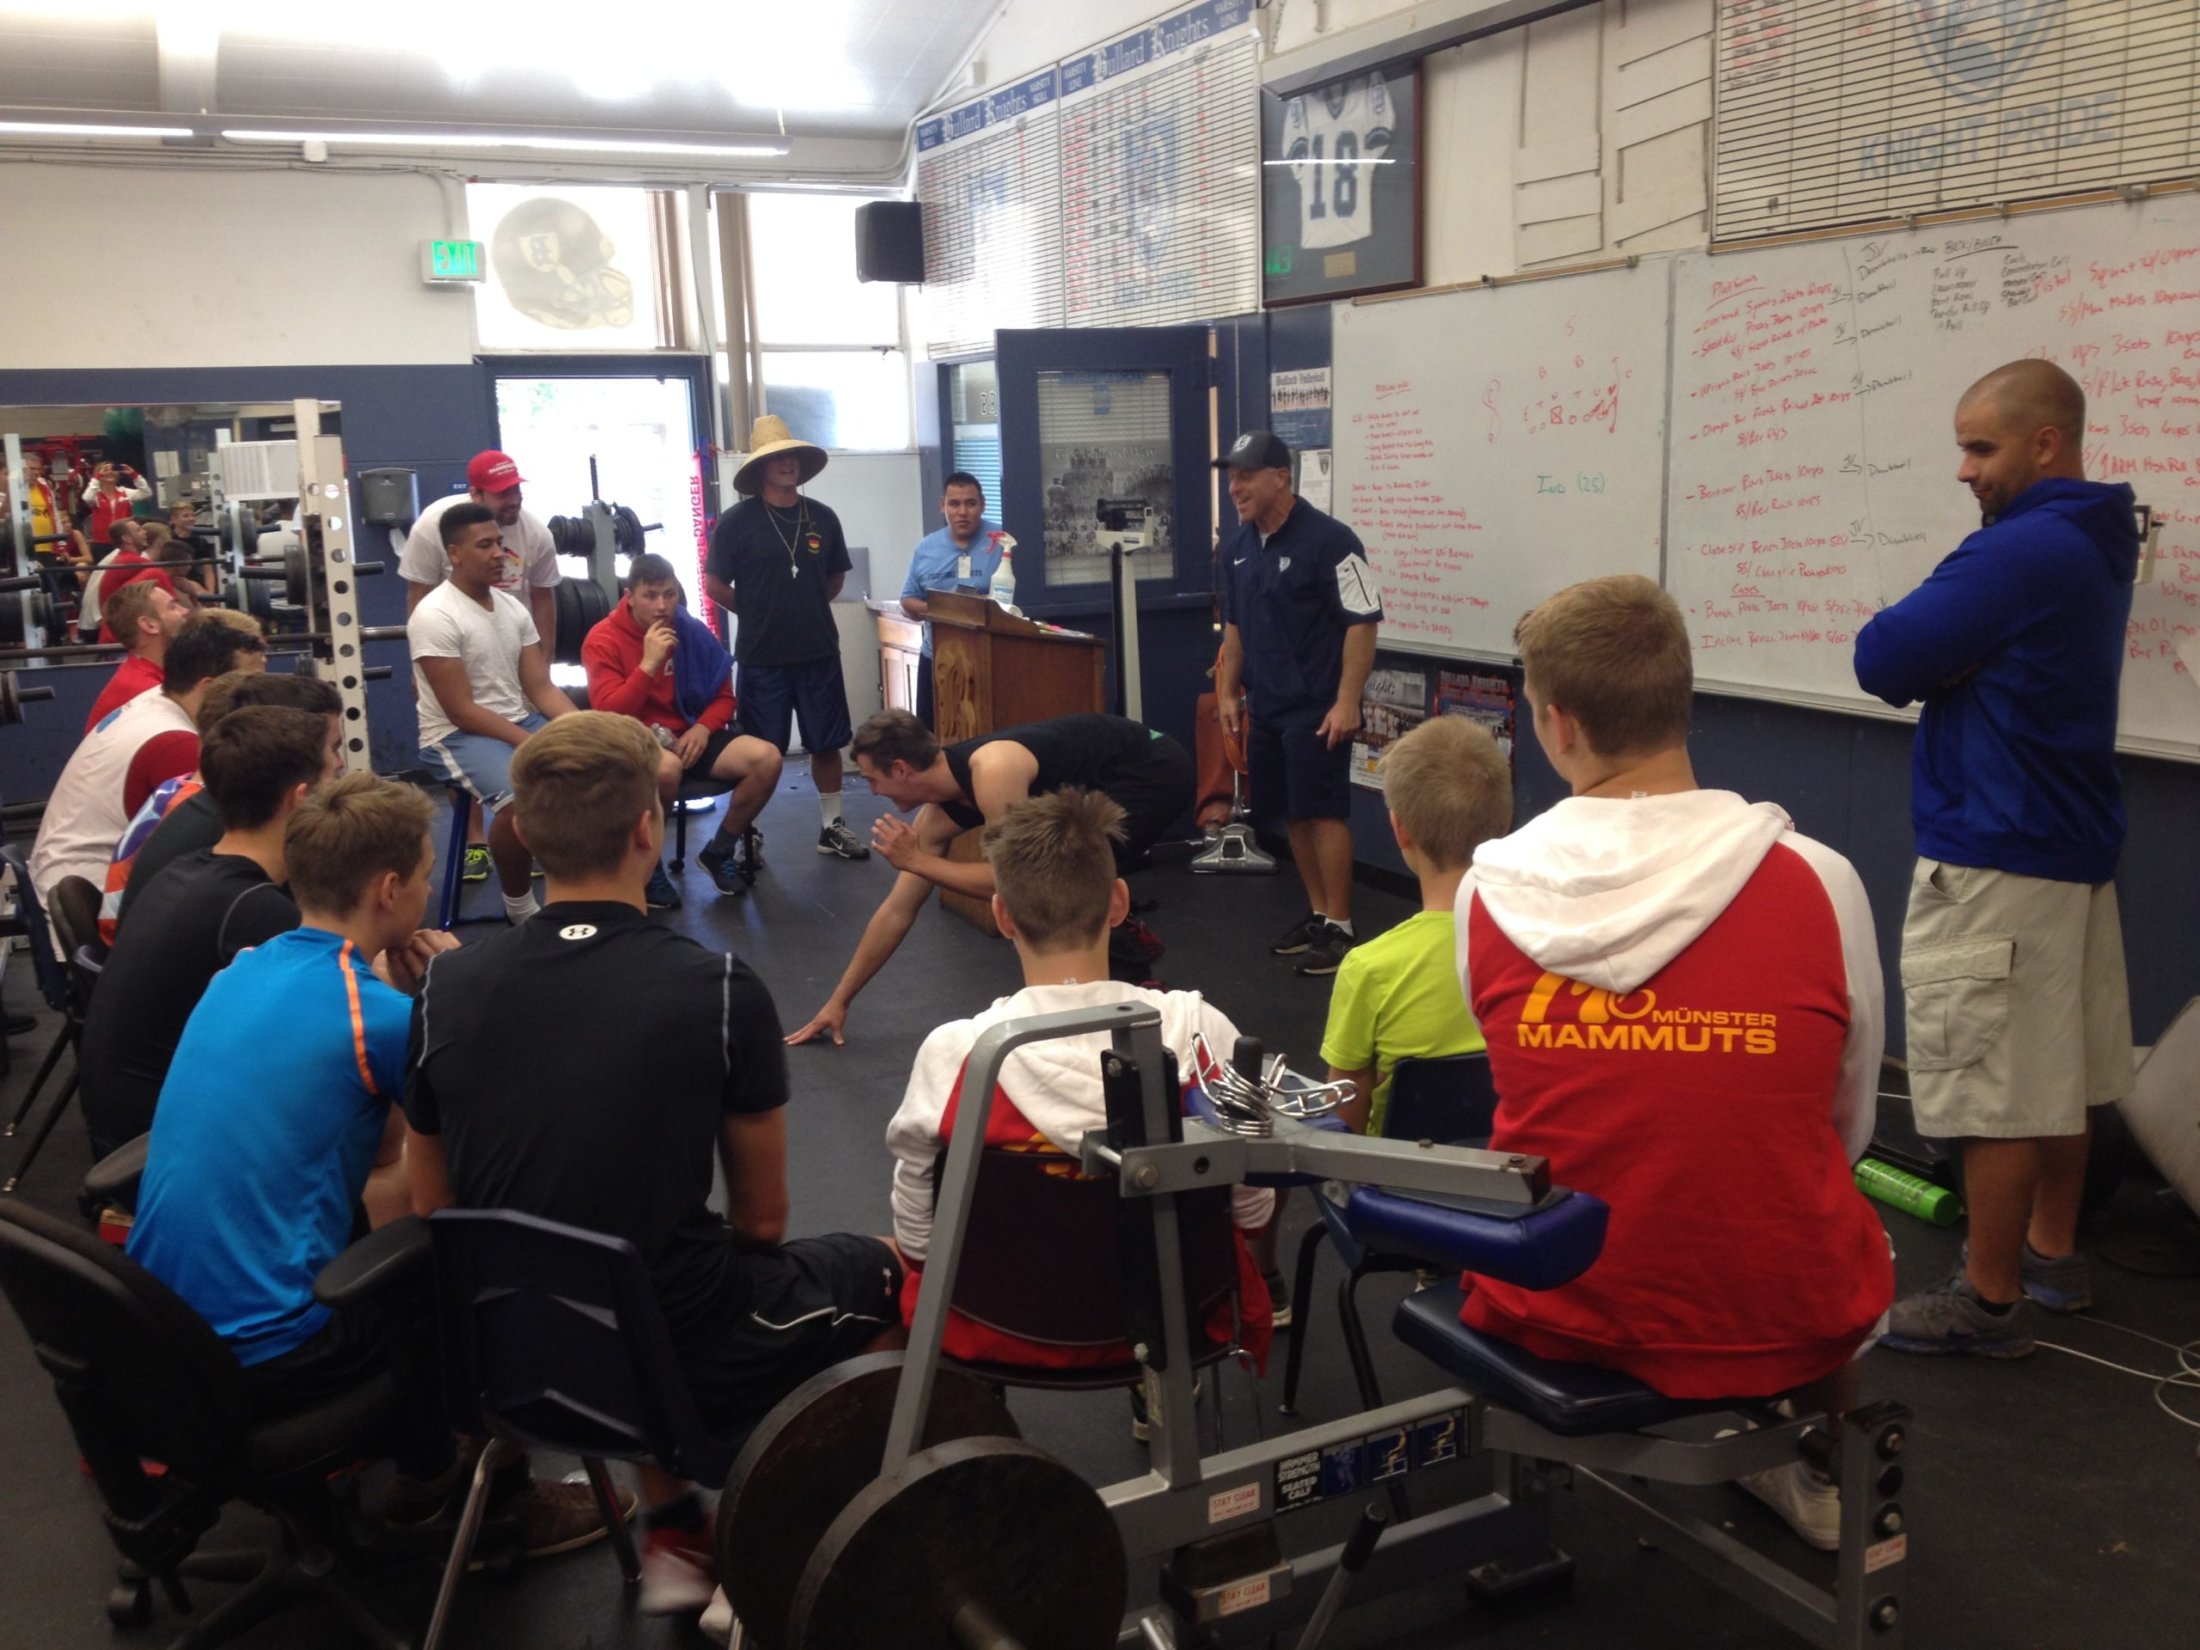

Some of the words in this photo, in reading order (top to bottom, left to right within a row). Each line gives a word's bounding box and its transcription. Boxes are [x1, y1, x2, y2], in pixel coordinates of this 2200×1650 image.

[1091, 34, 1145, 83] Bullard
[1151, 13, 1209, 61] Knights
[1860, 114, 1989, 180] KNIGHT
[2003, 91, 2118, 157] PRIDE
[1309, 130, 1359, 220] 18
[432, 240, 477, 276] EXIT
[1577, 471, 1605, 494] (25)
[1652, 1006, 1777, 1028] MÜNSTER
[1517, 1023, 1777, 1055] MAMMUTS
[1279, 1451, 1319, 1471] HAMMER
[1277, 1463, 1321, 1483] STRENGTH
[1281, 1477, 1318, 1495] SEATED
[1288, 1486, 1313, 1501] CALF
[1212, 1494, 1232, 1509] STAY
[1233, 1487, 1257, 1502] CLEAR
